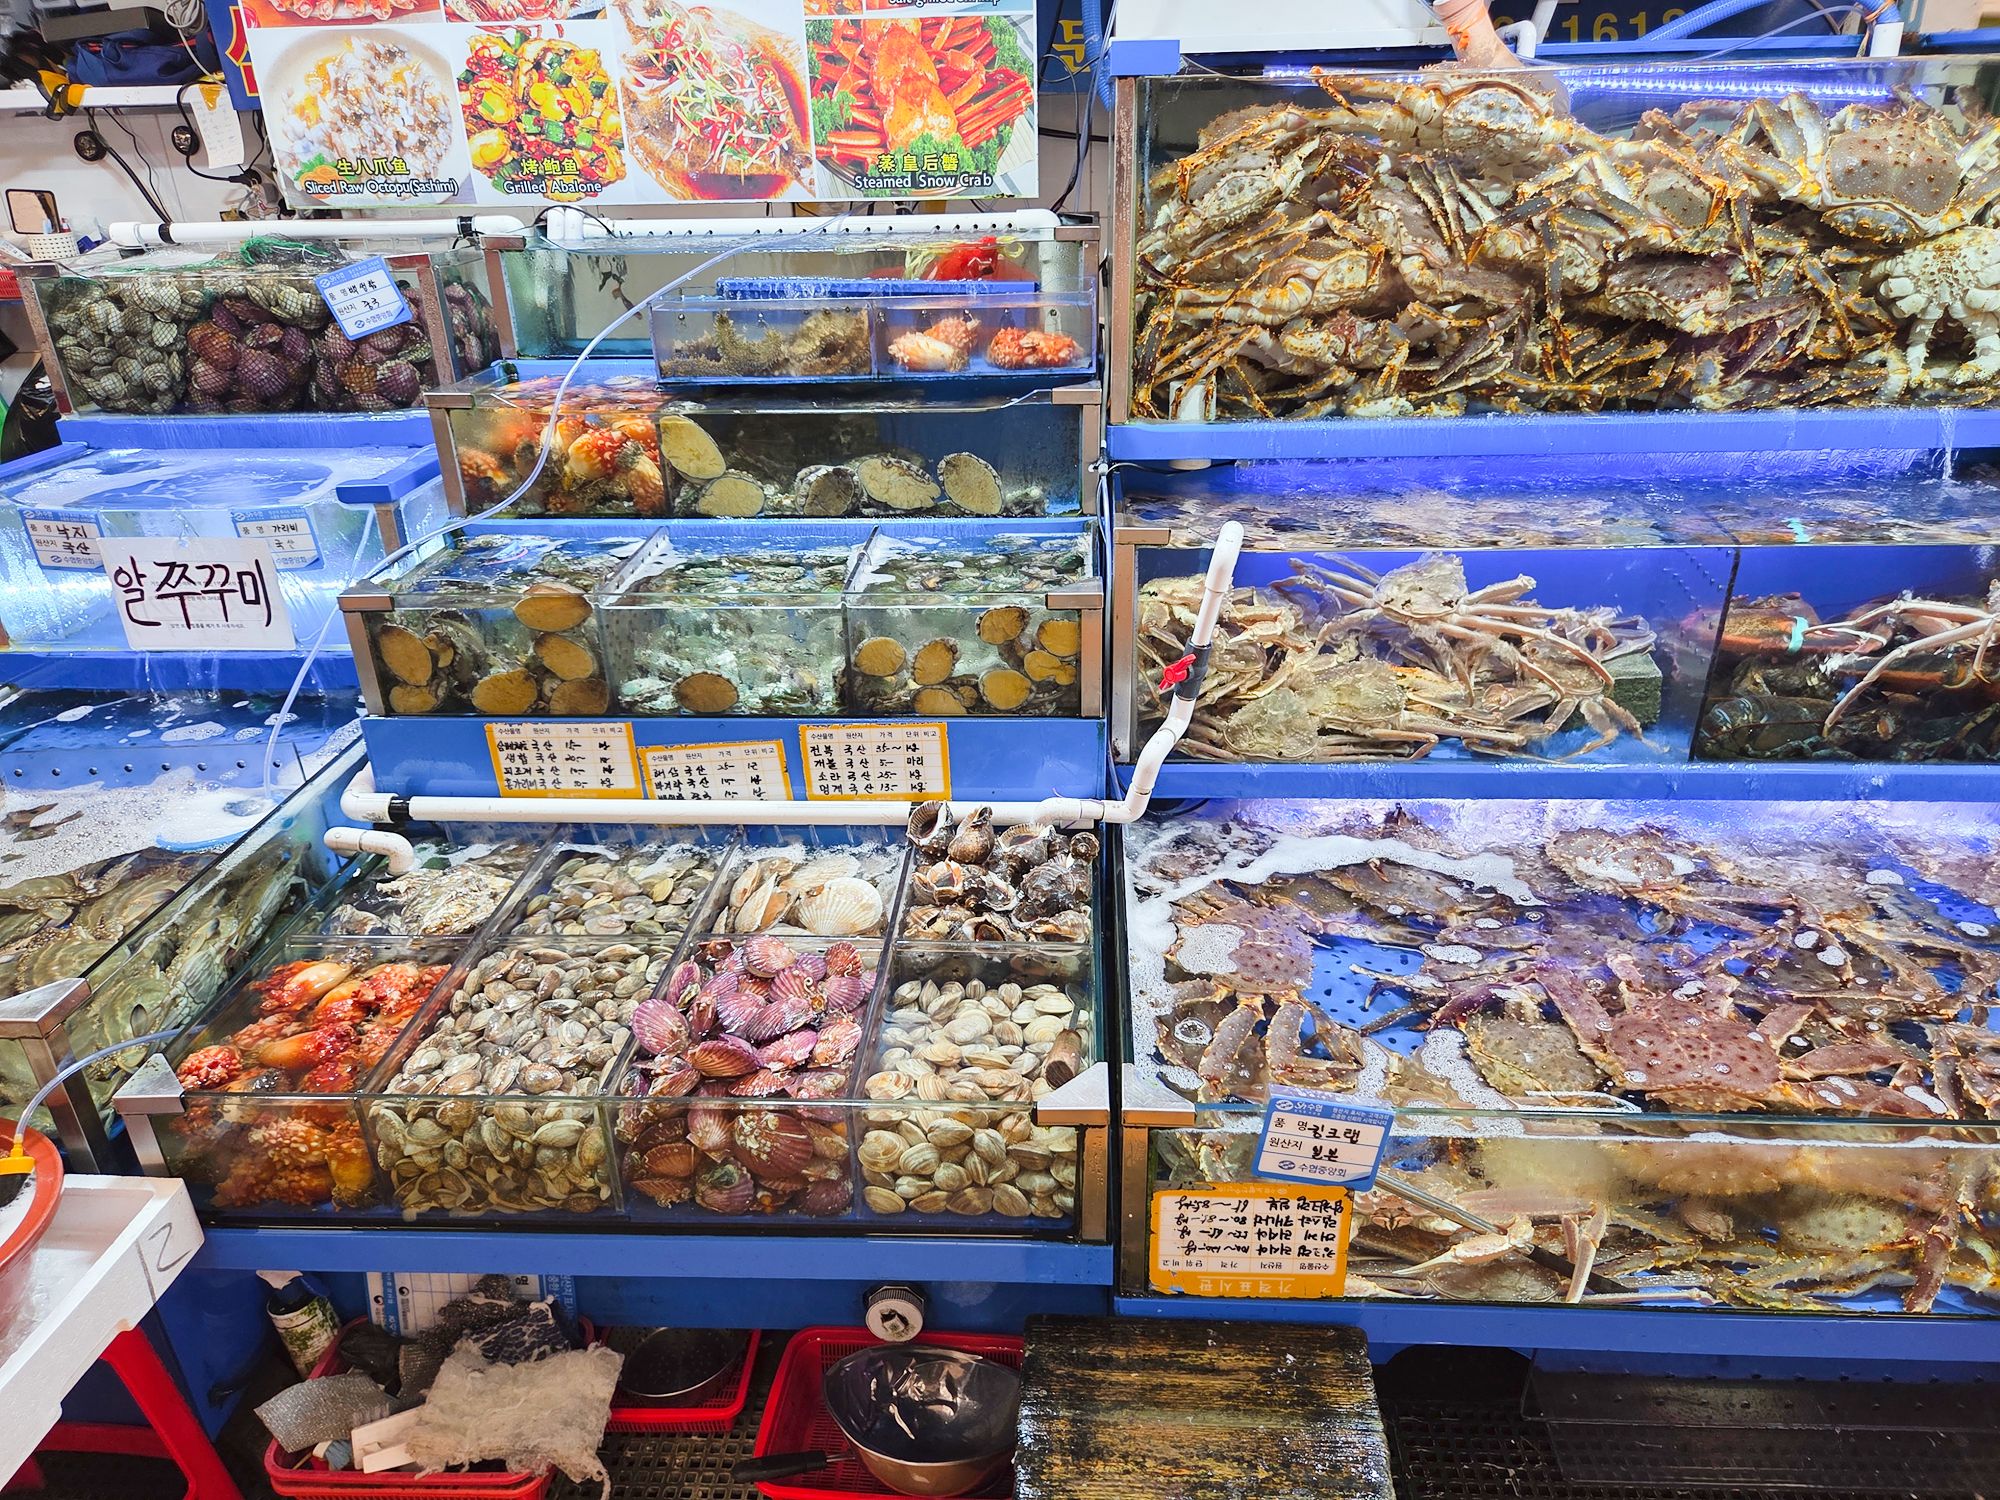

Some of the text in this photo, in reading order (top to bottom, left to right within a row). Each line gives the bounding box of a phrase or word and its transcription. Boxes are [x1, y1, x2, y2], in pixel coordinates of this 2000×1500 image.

[336, 158, 410, 176] 生八爪鱼
[521, 158, 580, 176] 烤鲍鱼
[878, 153, 958, 172] 蒸皇后蟹
[503, 179, 602, 194] Grilled Abalone
[855, 171, 993, 189] Steamed Snow Crab
[305, 179, 460, 197] Sliced Raw Octopu(Sashimi)
[56, 524, 88, 541] 낙지
[272, 523, 299, 533] 가리비
[62, 541, 91, 555] 국산
[274, 538, 295, 550] 국산
[114, 555, 272, 630] 알쭈꾸미
[810, 744, 834, 757] 전복
[844, 744, 867, 756] 국산
[814, 757, 837, 770] 개불
[845, 757, 870, 769] 국산
[906, 756, 924, 767] 마리
[684, 764, 707, 777] 국산
[818, 771, 842, 782] 소라
[847, 770, 872, 782] 국산
[686, 777, 710, 789] 국산
[819, 784, 843, 796] 멍게
[848, 782, 875, 795] 국산
[1307, 1124, 1361, 1144] 킹크랩
[1268, 1136, 1339, 1163] 원산지 일본
[1298, 1163, 1347, 1178] 수협중앙회
[1255, 1228, 1292, 1241] 러시아
[1256, 1243, 1292, 1256] 러시아
[1297, 1245, 1336, 1257] 킹크랩
[1260, 1261, 1283, 1269] 원산지
[1299, 1262, 1330, 1271] 수산물명
